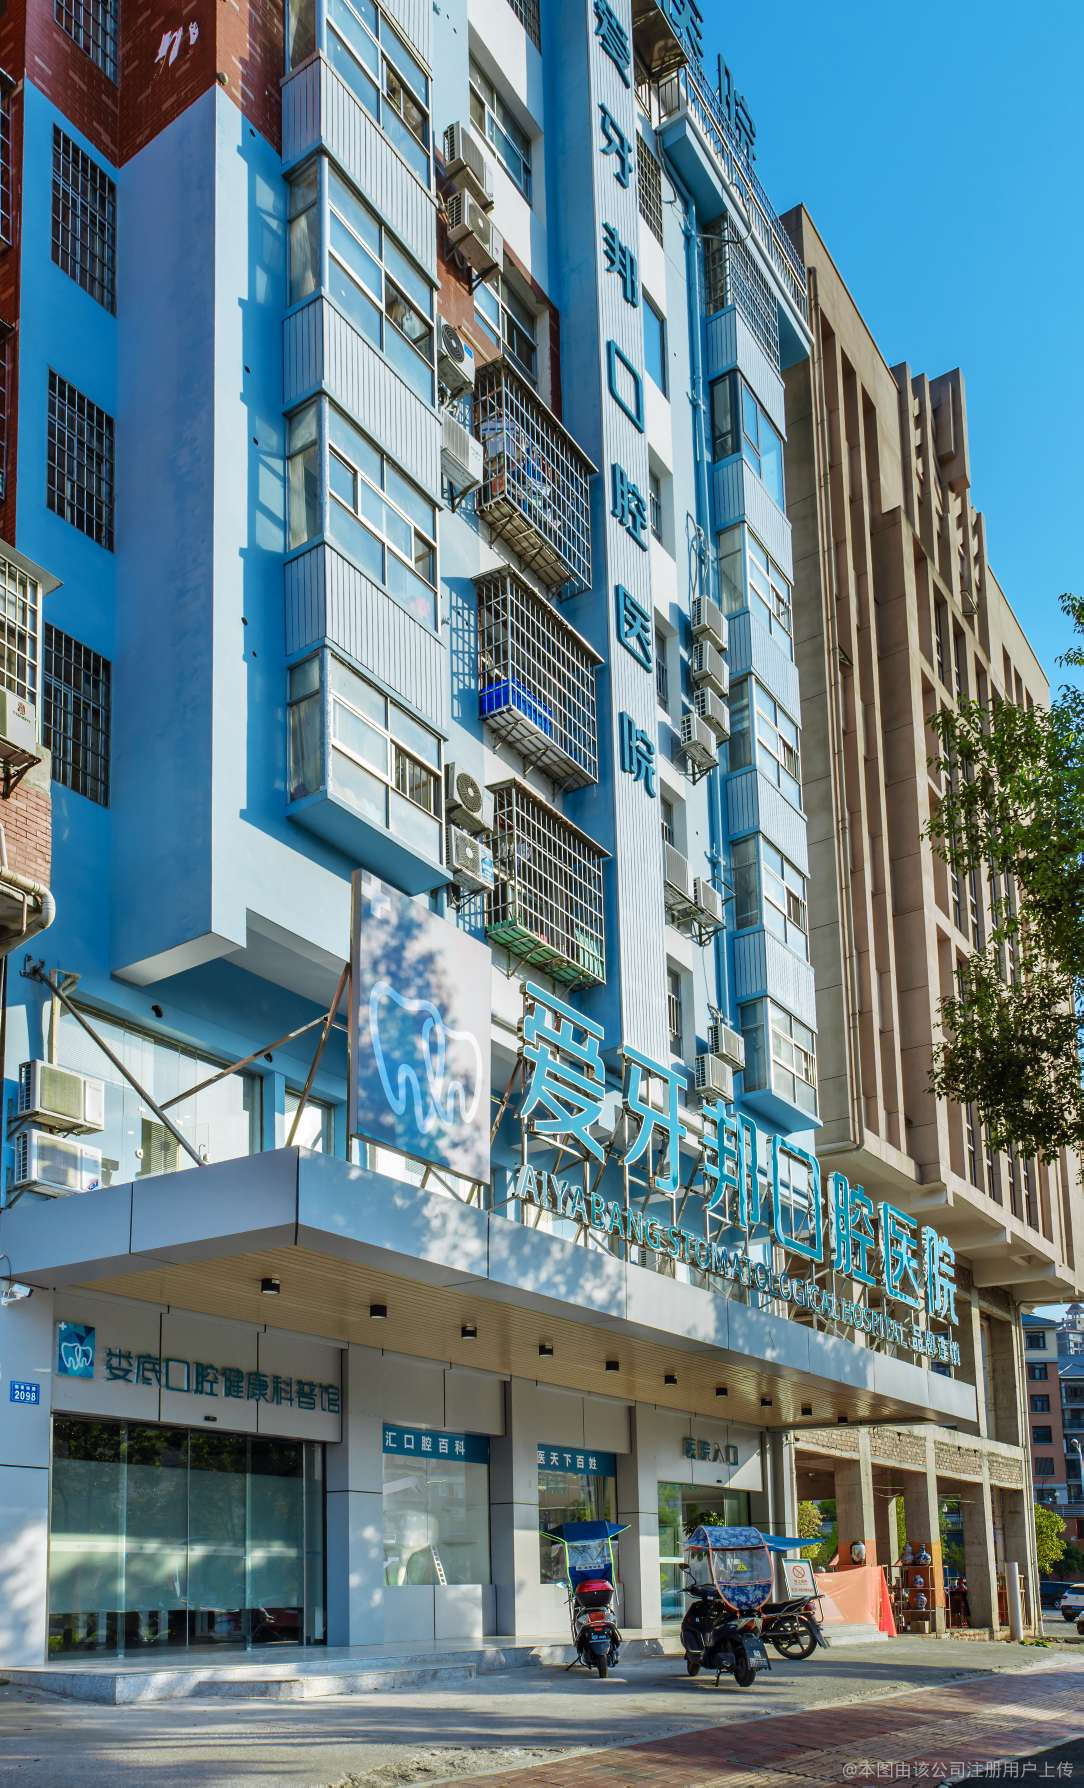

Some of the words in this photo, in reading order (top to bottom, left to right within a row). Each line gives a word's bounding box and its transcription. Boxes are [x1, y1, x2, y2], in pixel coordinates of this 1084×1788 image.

[520, 980, 960, 1326] 爱牙邦口腔医院
[517, 1163, 662, 1249] AIYABANG
[664, 1225, 838, 1322] STOMATOLOGICAL
[842, 1297, 908, 1349] HOSPITAL
[14, 1390, 37, 1402] 2098
[105, 1347, 341, 1415] 娄底口腔健康科普馆
[385, 1431, 466, 1456] 汇口腔百科
[536, 1450, 599, 1470] 医天下百姓
